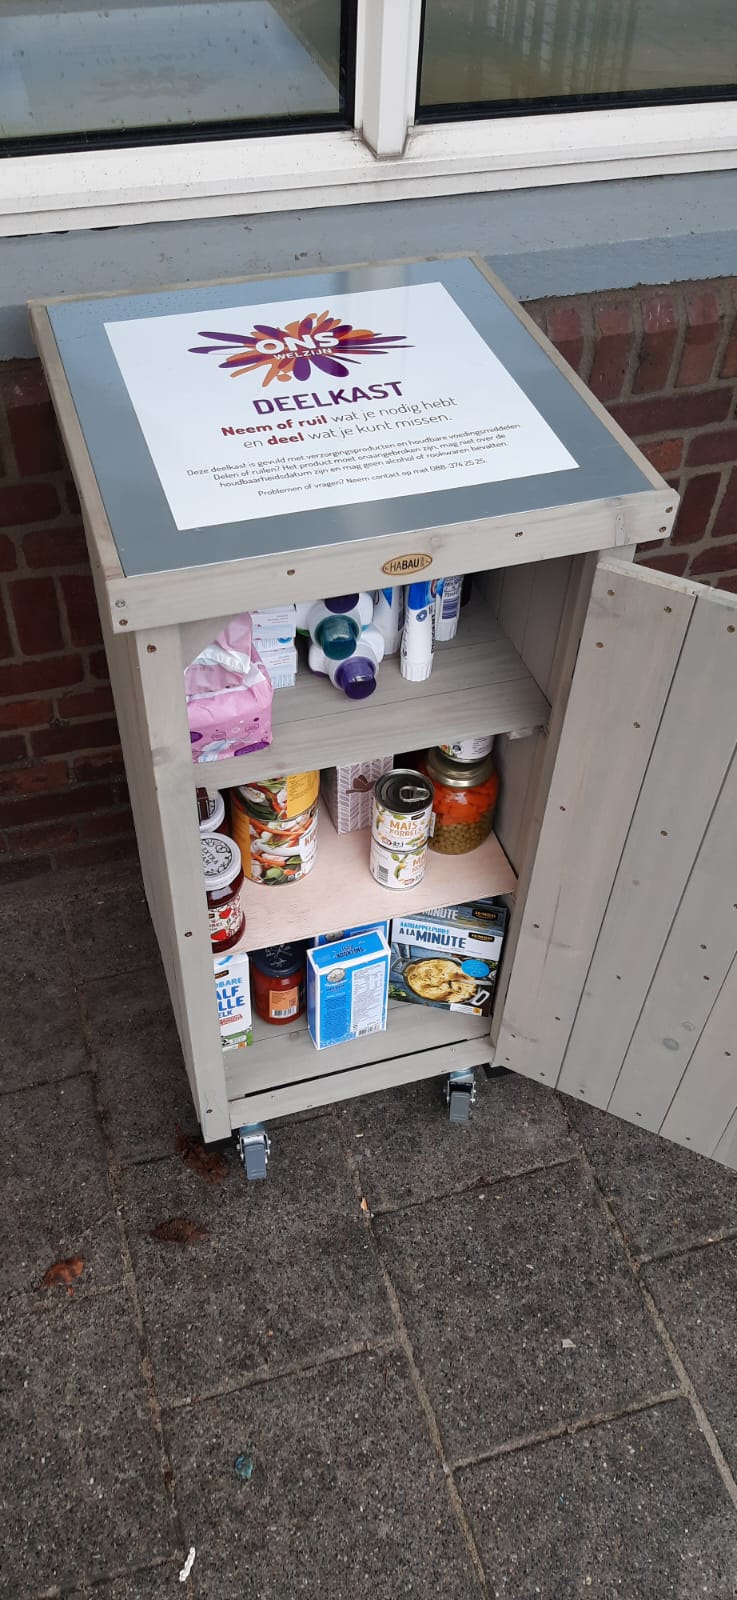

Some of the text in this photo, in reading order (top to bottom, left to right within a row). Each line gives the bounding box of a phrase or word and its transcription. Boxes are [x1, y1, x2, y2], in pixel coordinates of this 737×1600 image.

[255, 332, 339, 355] ONS
[274, 348, 332, 361] WELZIJN
[252, 381, 402, 415] DEELKAST
[220, 397, 458, 437] Neem of ruil wat je nodig hebt
[243, 413, 453, 448] en deel wat je kunt missen.
[211, 463, 246, 472] deelkast
[257, 457, 286, 467] gevuld
[305, 443, 396, 459] verzorgingsproducten
[408, 436, 448, 446] houdbare
[213, 472, 239, 480] Delen
[252, 465, 280, 475] ruilen?
[300, 459, 333, 469] product
[333, 456, 356, 464] moet
[460, 438, 475, 446] niet
[220, 470, 312, 487] houdbaarheidsdatum
[363, 460, 384, 469] geen
[385, 455, 415, 465] alcohol
[257, 484, 303, 496] Problemen
[314, 478, 345, 488] vragen?
[371, 471, 401, 480] contact
[390, 557, 420, 572] HABAU
[389, 820, 418, 831] MAIS
[416, 930, 467, 949] MINUTE
